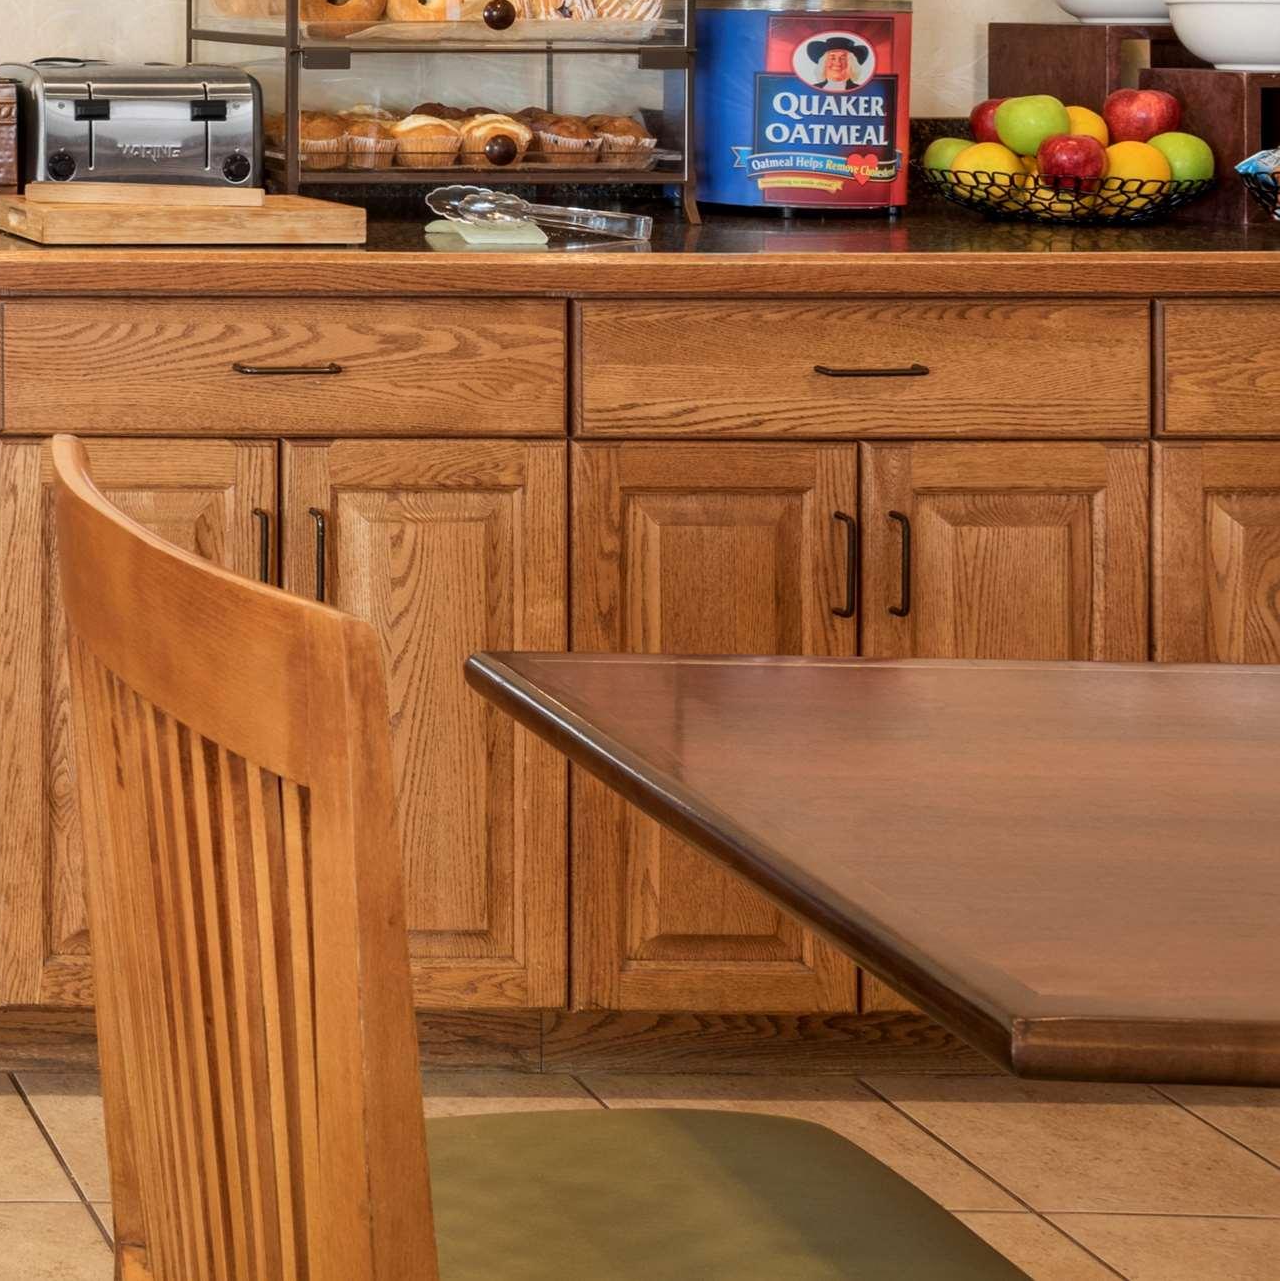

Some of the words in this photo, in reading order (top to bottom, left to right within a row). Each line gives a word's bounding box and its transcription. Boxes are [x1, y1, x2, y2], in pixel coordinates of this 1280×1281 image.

[772, 92, 886, 119] QUAKER
[765, 123, 888, 145] OATMEAL
[752, 156, 793, 170] Oatmeal
[796, 157, 823, 169] Helps
[826, 160, 859, 175] Remove
